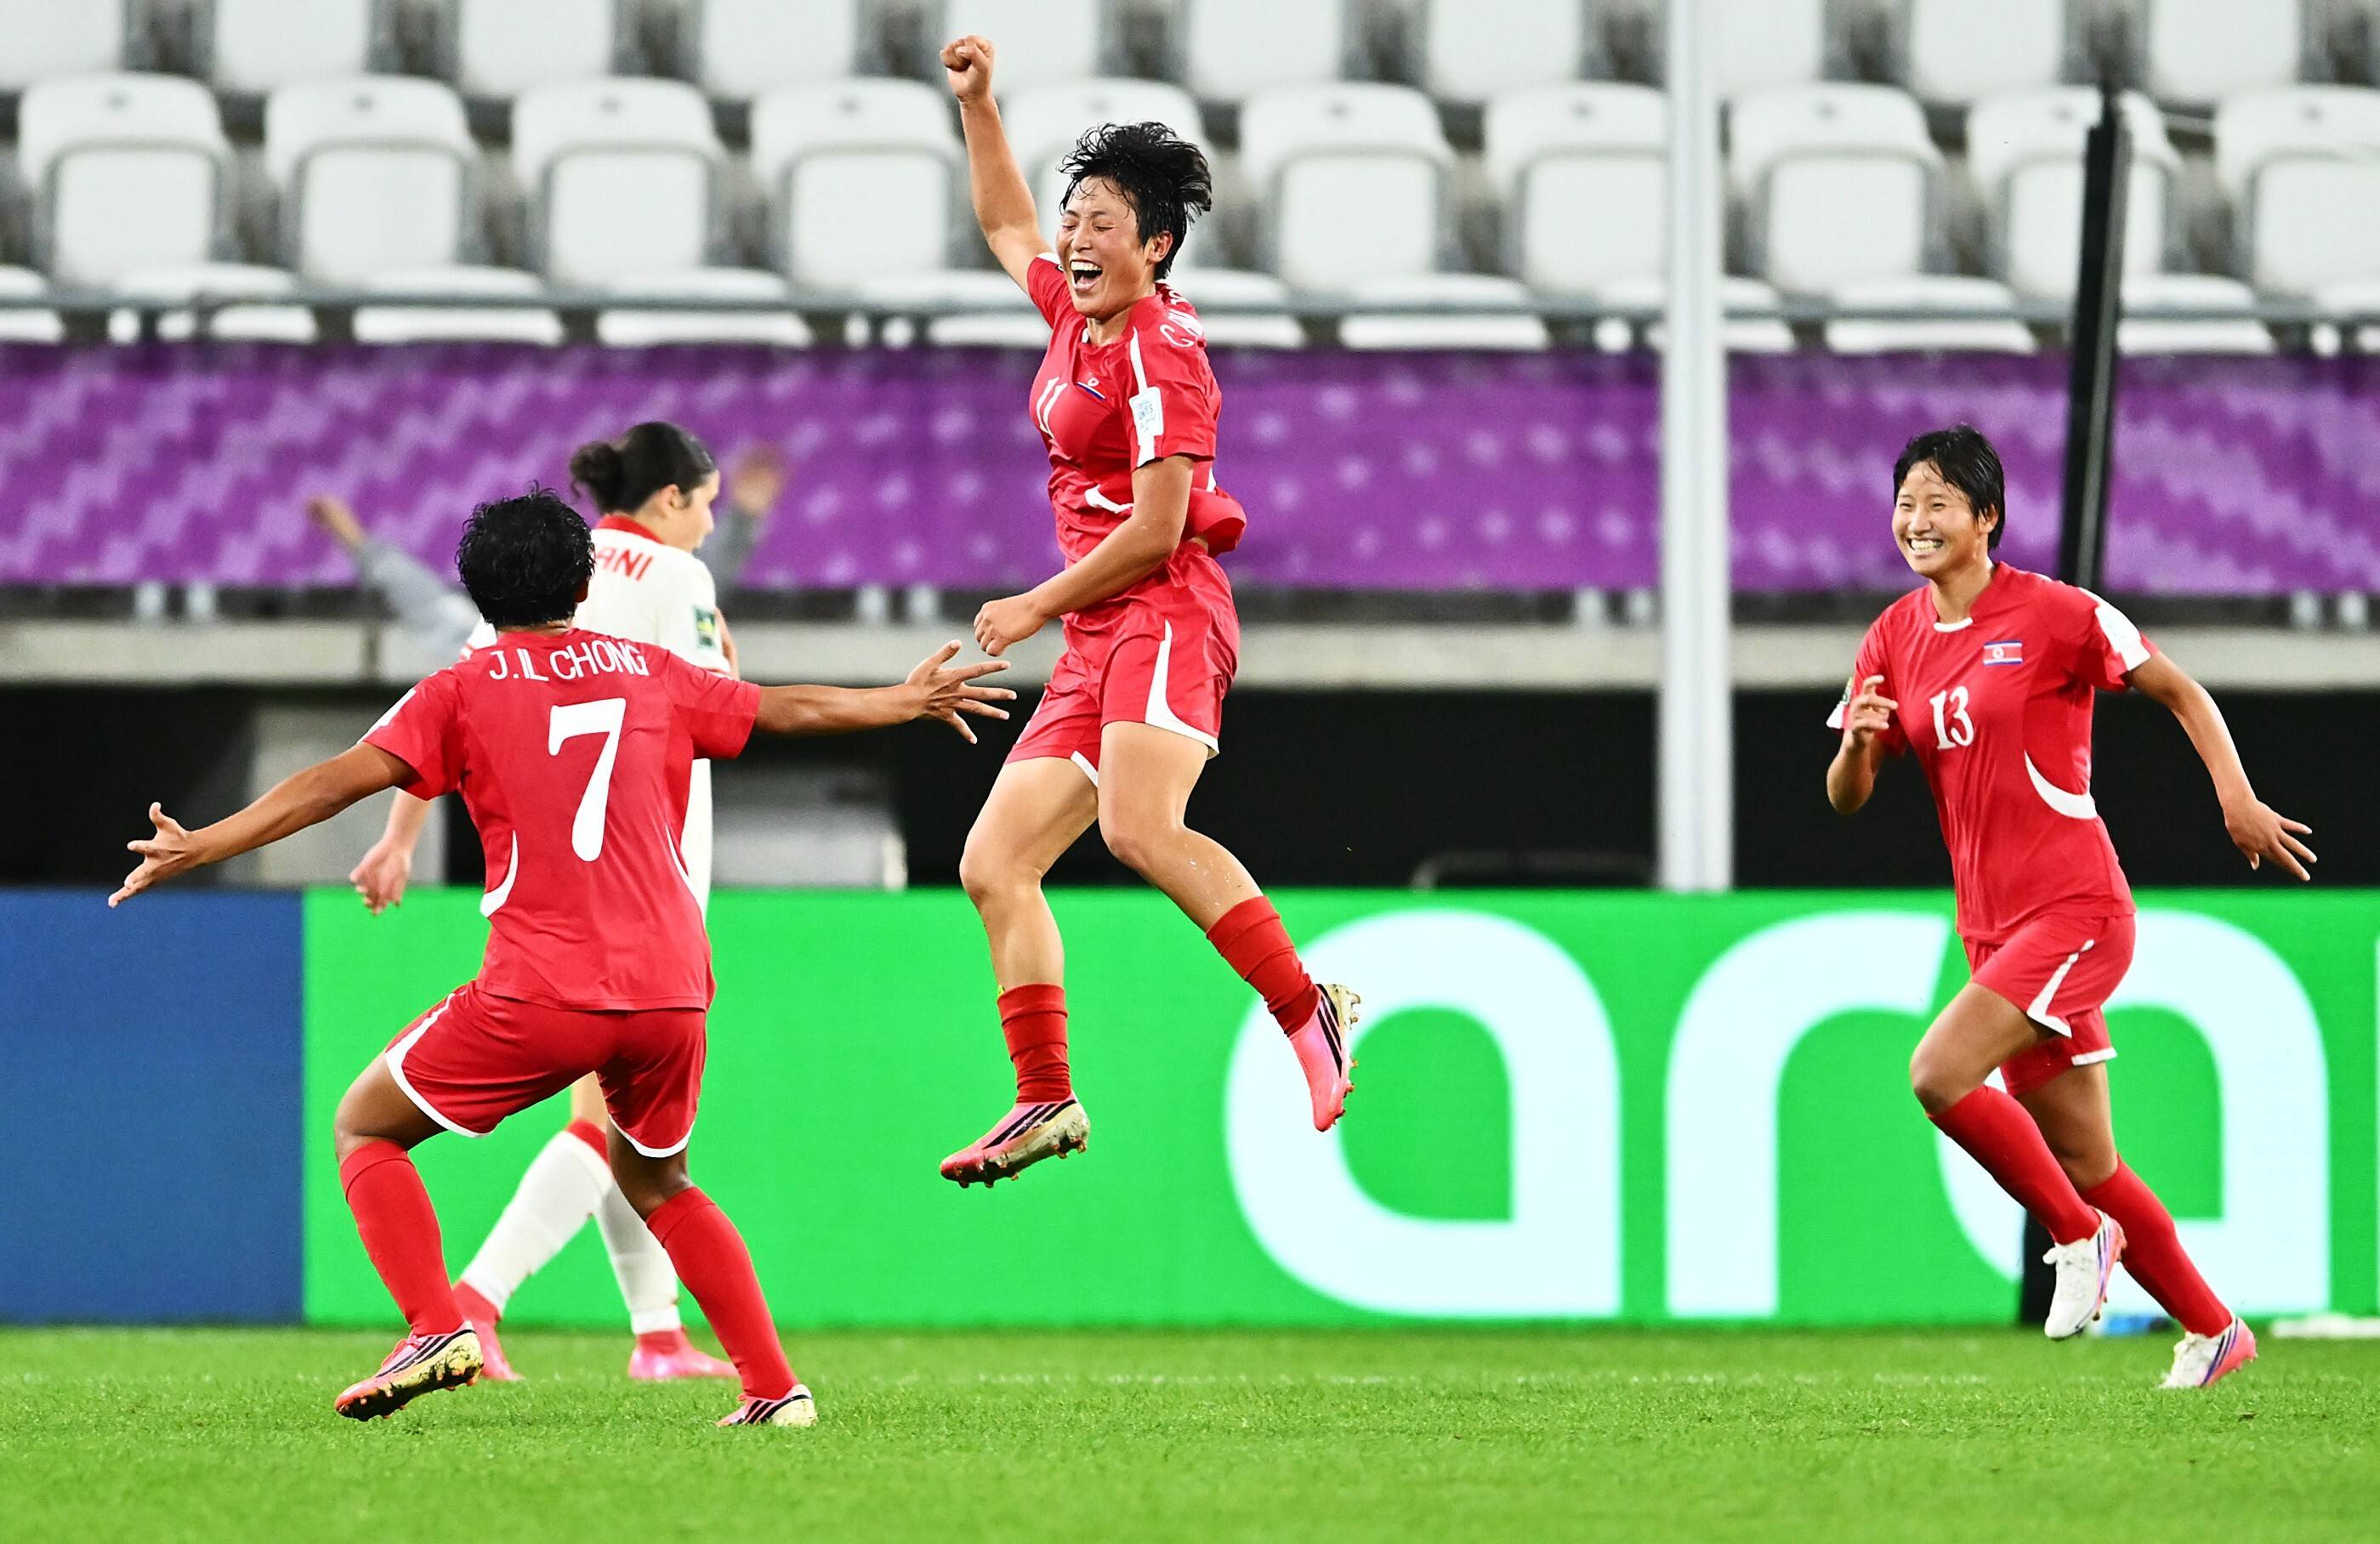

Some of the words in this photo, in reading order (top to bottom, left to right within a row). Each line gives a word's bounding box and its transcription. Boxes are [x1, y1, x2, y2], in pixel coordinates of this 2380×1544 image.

[549, 639, 650, 680] CHONG
[1928, 685, 1975, 751] 13
[548, 697, 627, 862] 7
[1225, 910, 2380, 1316] ara
